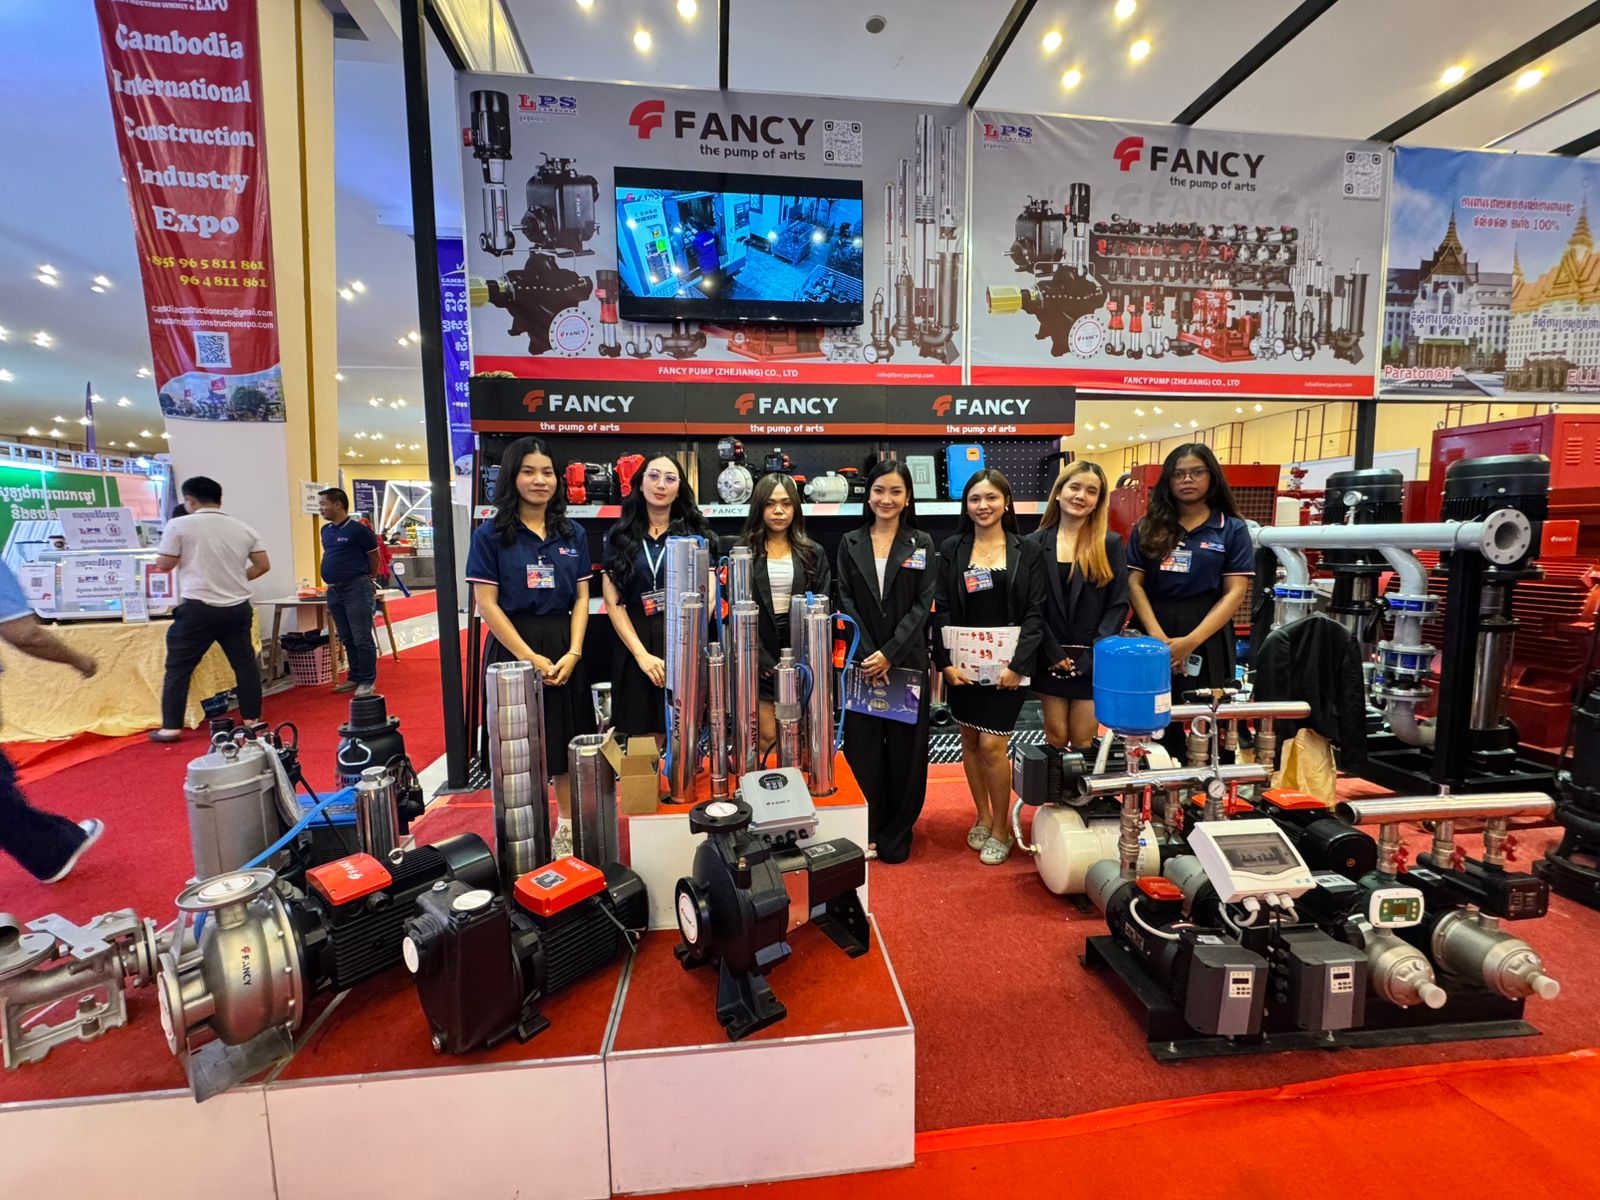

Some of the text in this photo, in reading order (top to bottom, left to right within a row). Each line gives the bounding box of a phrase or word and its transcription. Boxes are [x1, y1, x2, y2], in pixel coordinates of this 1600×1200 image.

[115, 23, 244, 59] Cambodia
[112, 69, 252, 103] International
[517, 94, 577, 111] LPS
[123, 115, 255, 147] Construction
[674, 110, 815, 146] FANCY
[983, 123, 1033, 140] LPS
[699, 143, 806, 161] the pump of arts
[1150, 145, 1265, 179] FANCY
[137, 161, 250, 194] Industry
[1169, 176, 1257, 192] the pump of arts
[152, 205, 240, 239] Expo
[1533, 218, 1560, 231] 100%
[178, 258, 198, 268] 96
[200, 259, 209, 269] 5
[211, 258, 237, 269] 811
[240, 260, 265, 270] 861
[180, 275, 267, 288] 96 4 811 861
[658, 366, 798, 378] FANCY PUMP (ZHEJIANG) CO., LTD
[1123, 376, 1149, 385] FANCY
[1149, 376, 1171, 385] PUMP
[1171, 377, 1211, 387] (ZHEJIANG)
[1227, 379, 1240, 387] LTD
[549, 394, 635, 413] FANCY
[758, 397, 839, 415] FANCY
[955, 398, 1031, 416] FANCY
[540, 421, 620, 433] the pump of arts
[750, 424, 824, 434] the pump of arts
[946, 424, 1017, 435] the pump of arts
[712, 507, 744, 516] FANCY
[672, 706, 680, 741] FANCY
[241, 955, 252, 986] FANCY
